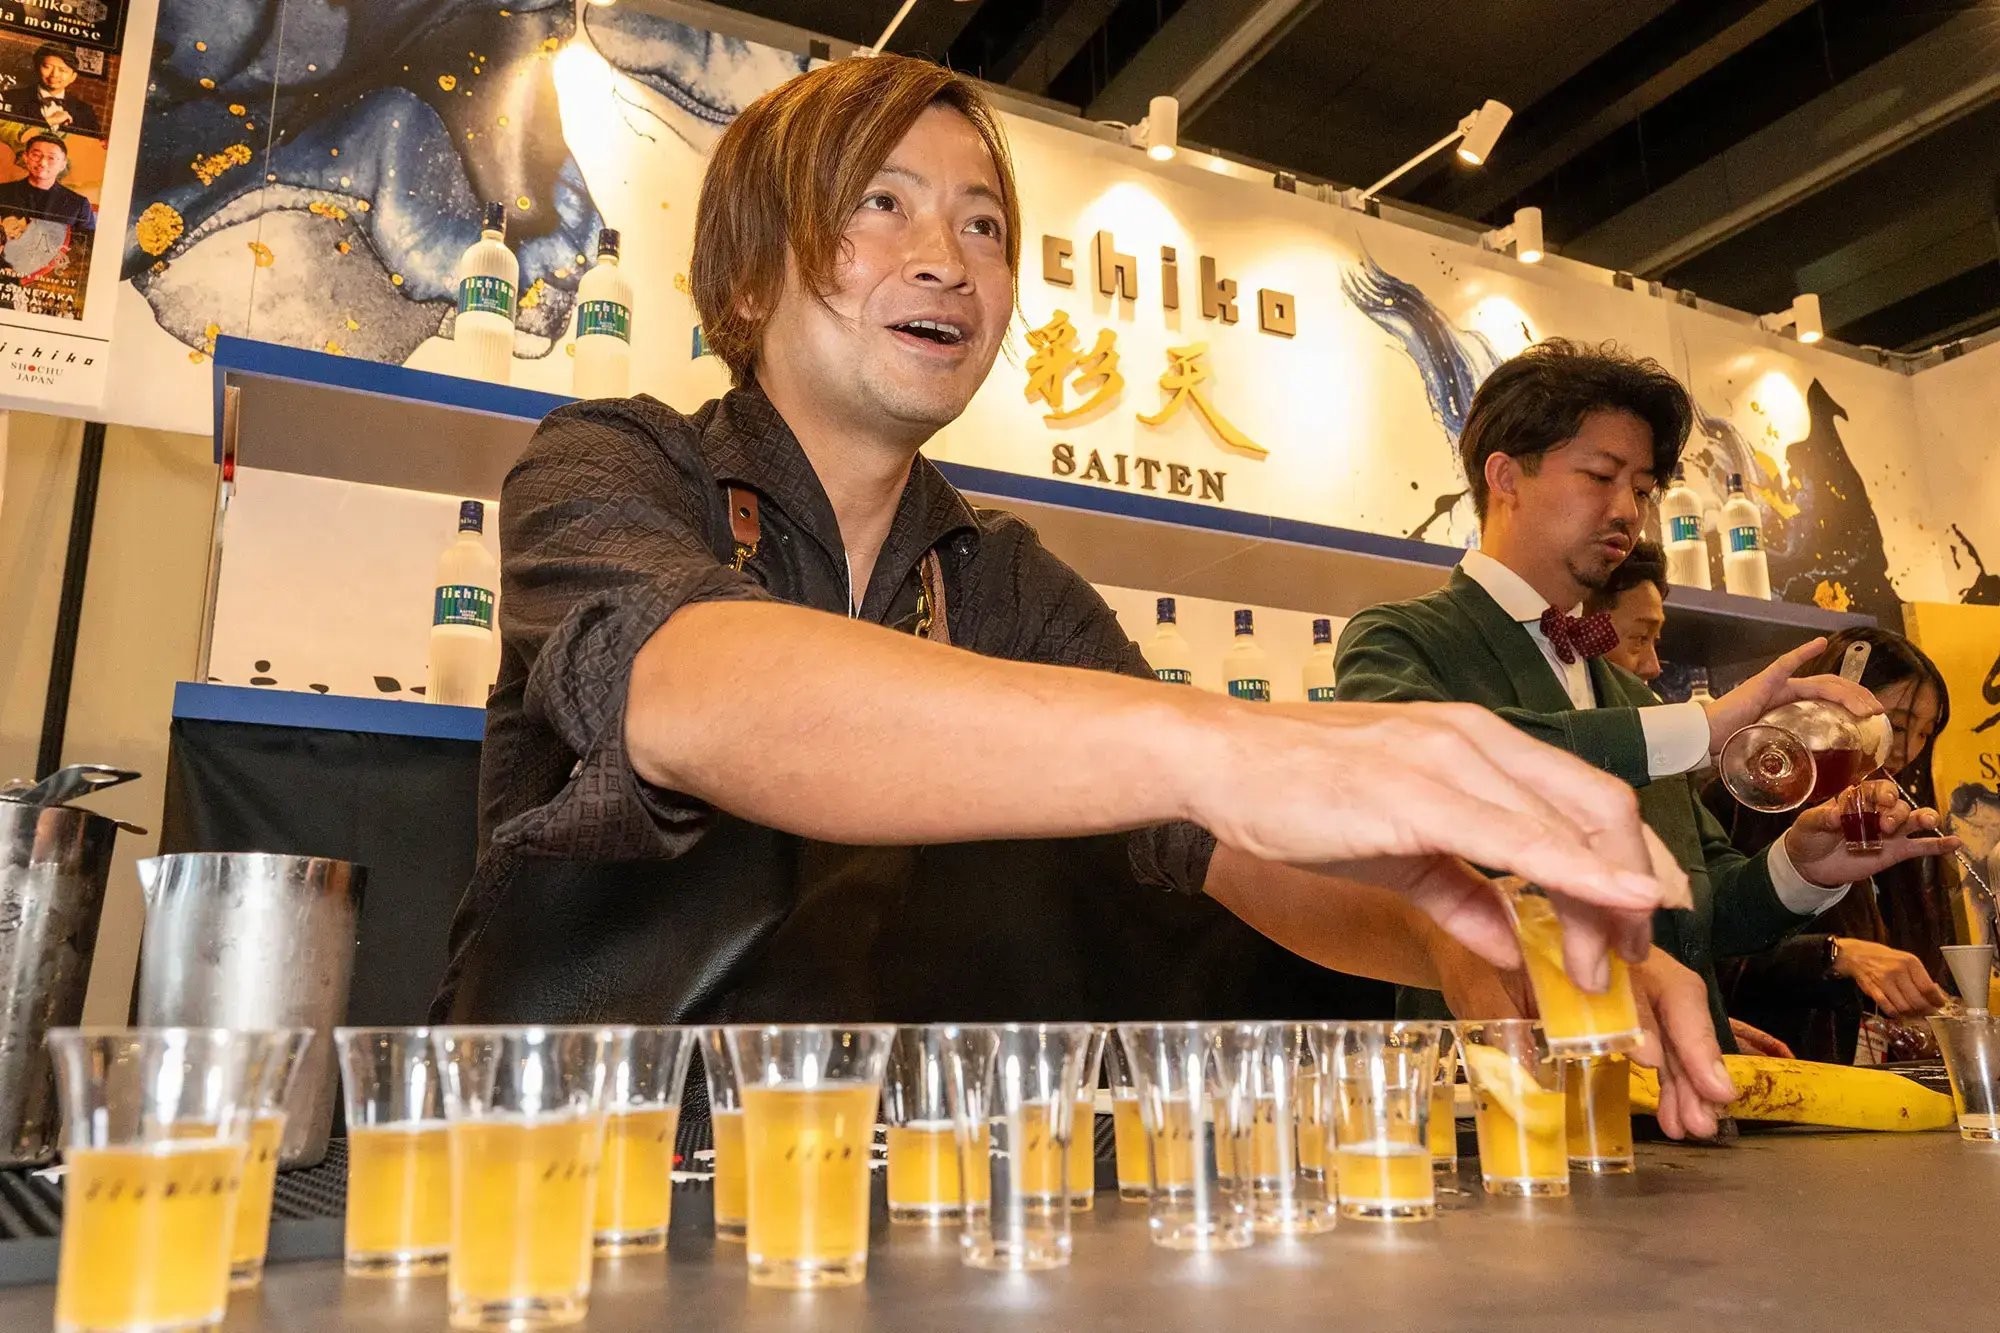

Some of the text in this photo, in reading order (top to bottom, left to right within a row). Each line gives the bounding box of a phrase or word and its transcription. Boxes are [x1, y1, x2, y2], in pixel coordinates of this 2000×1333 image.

[24, 16, 101, 41] momose
[62, 278, 77, 287] NY
[16, 373, 54, 385] JAPAN
[1024, 308, 1270, 462] 彩天
[1051, 443, 1228, 503] SAITEN
